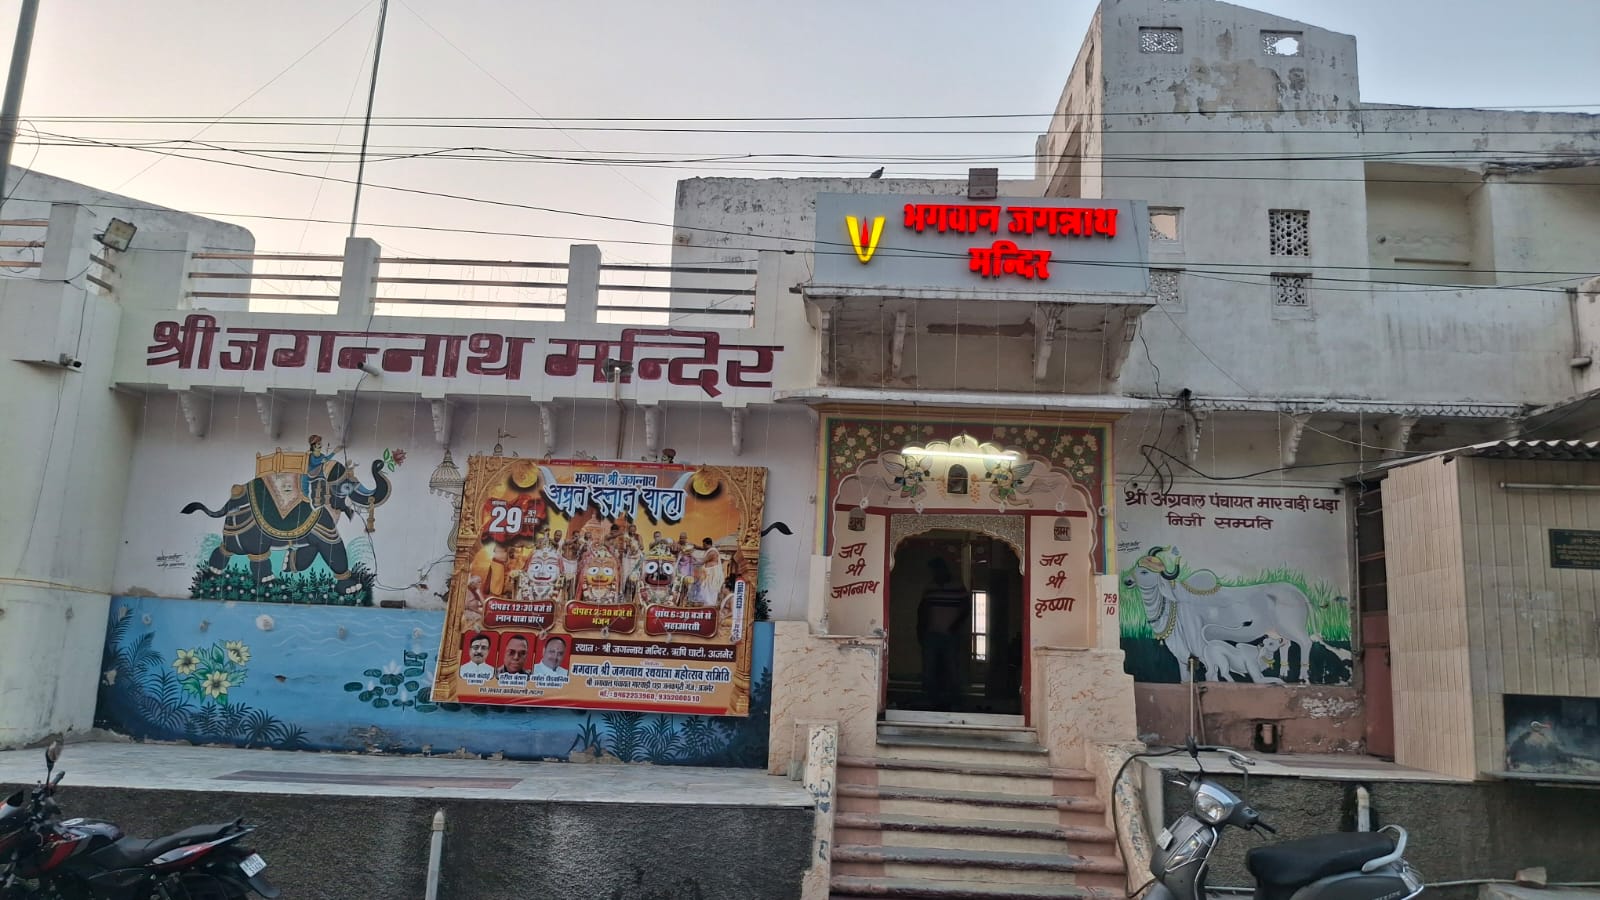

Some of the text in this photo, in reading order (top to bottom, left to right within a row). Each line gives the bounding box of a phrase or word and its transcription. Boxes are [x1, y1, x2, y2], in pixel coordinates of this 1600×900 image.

[903, 203, 1119, 238] भगवान जगन्नाथ
[968, 240, 1053, 280] मन्दिर
[147, 313, 785, 398] श्री जगन्नाथ मन्दिर
[575, 471, 656, 487] भगवान श्री जगन्नाथ
[591, 487, 637, 519] स्नान
[1124, 489, 1340, 517] श्री अग्रवाल पंचायत मारवाड़ी धड़ा
[489, 506, 522, 534] 29
[1165, 511, 1206, 528] निजी
[838, 542, 867, 559] जय
[1039, 552, 1068, 567] जय
[845, 557, 866, 577] श्री
[1045, 569, 1067, 589] श्री
[1103, 592, 1117, 604] 759
[512, 604, 533, 612] 12:30
[670, 611, 690, 619] 6:30
[1106, 605, 1115, 616] 10
[575, 643, 594, 652] स्थान
[602, 642, 611, 654] श्री
[612, 645, 643, 654] जगन्नाथ
[708, 648, 734, 659] अजमेर
[572, 661, 731, 682] भगवान श्री जगन्नाथ रथयात्रा महोत्सव समिति
